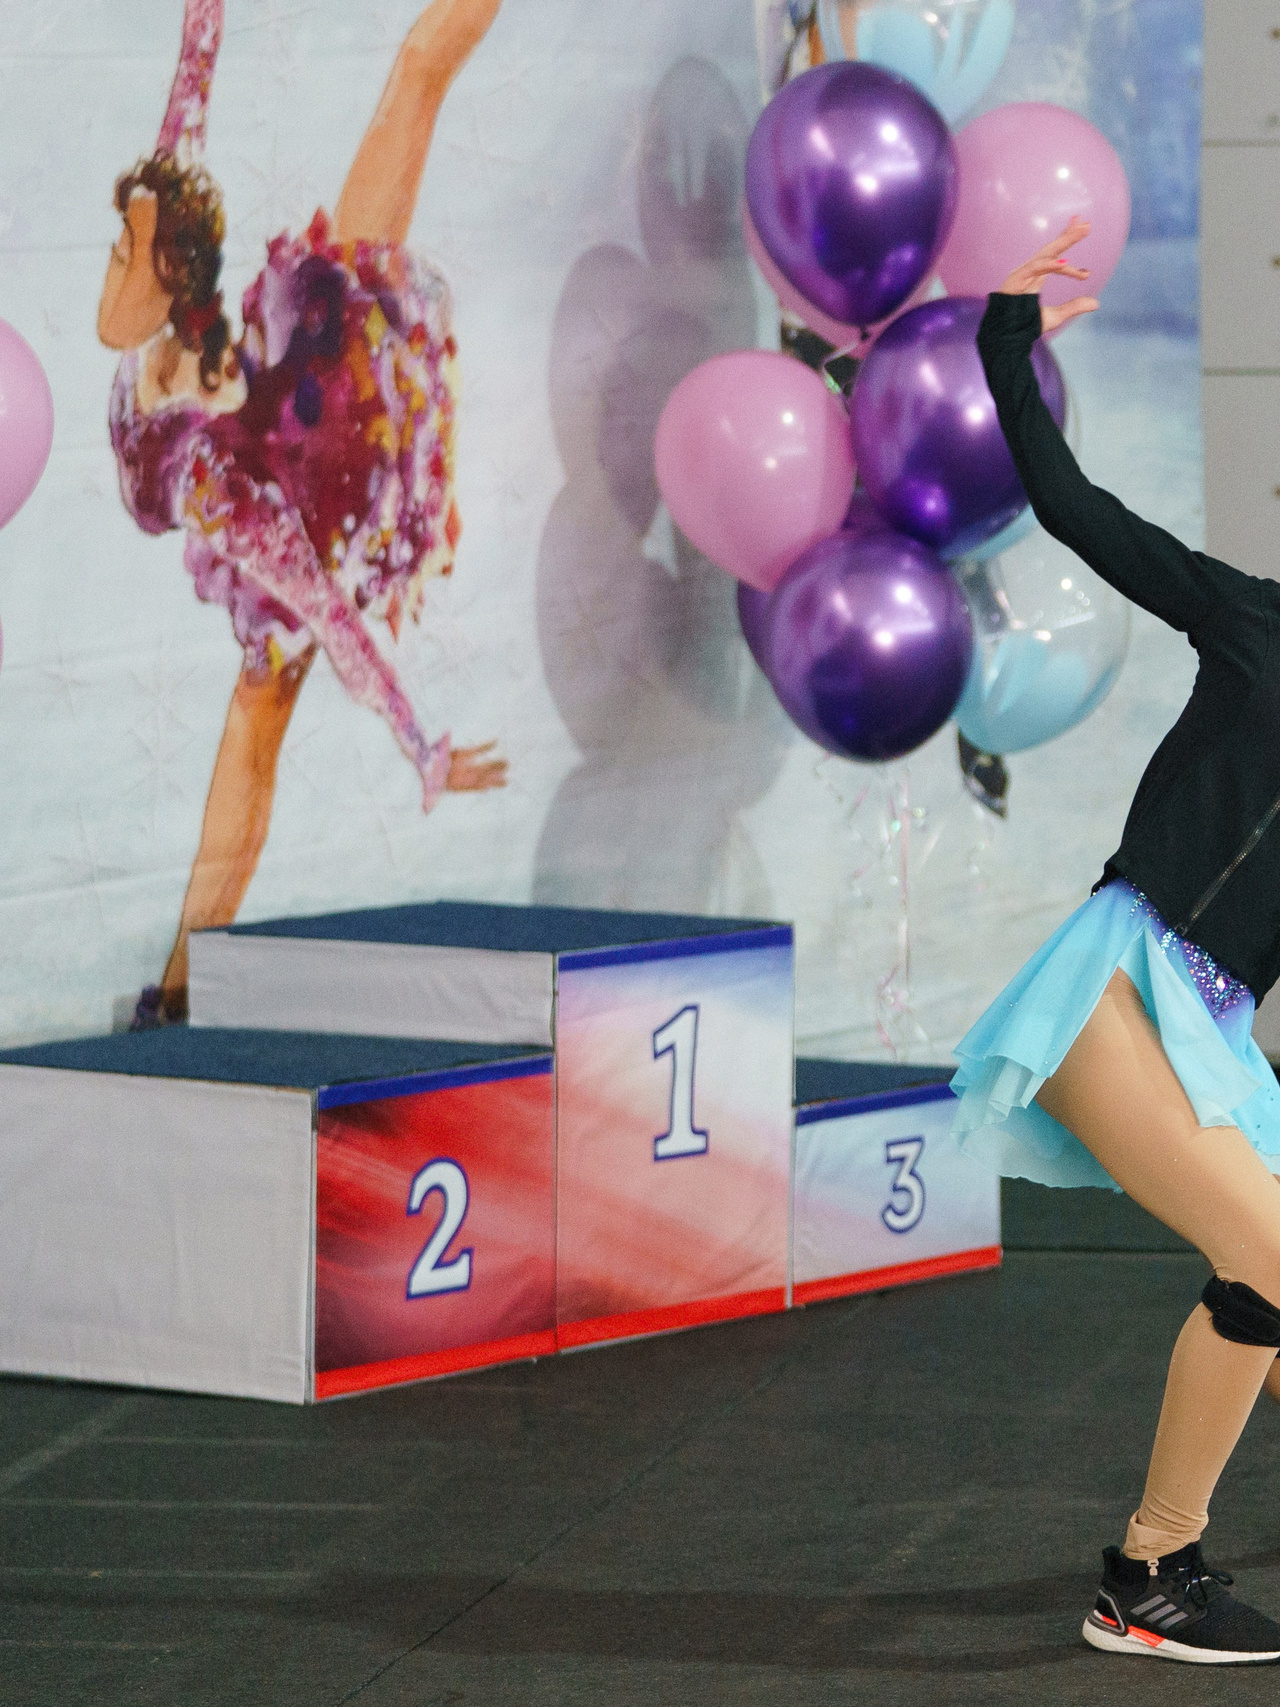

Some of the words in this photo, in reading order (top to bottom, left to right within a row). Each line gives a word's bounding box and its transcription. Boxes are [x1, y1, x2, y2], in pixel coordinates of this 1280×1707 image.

[653, 1003, 709, 1162] 1
[405, 1156, 474, 1300] 2
[882, 1135, 926, 1234] 3
